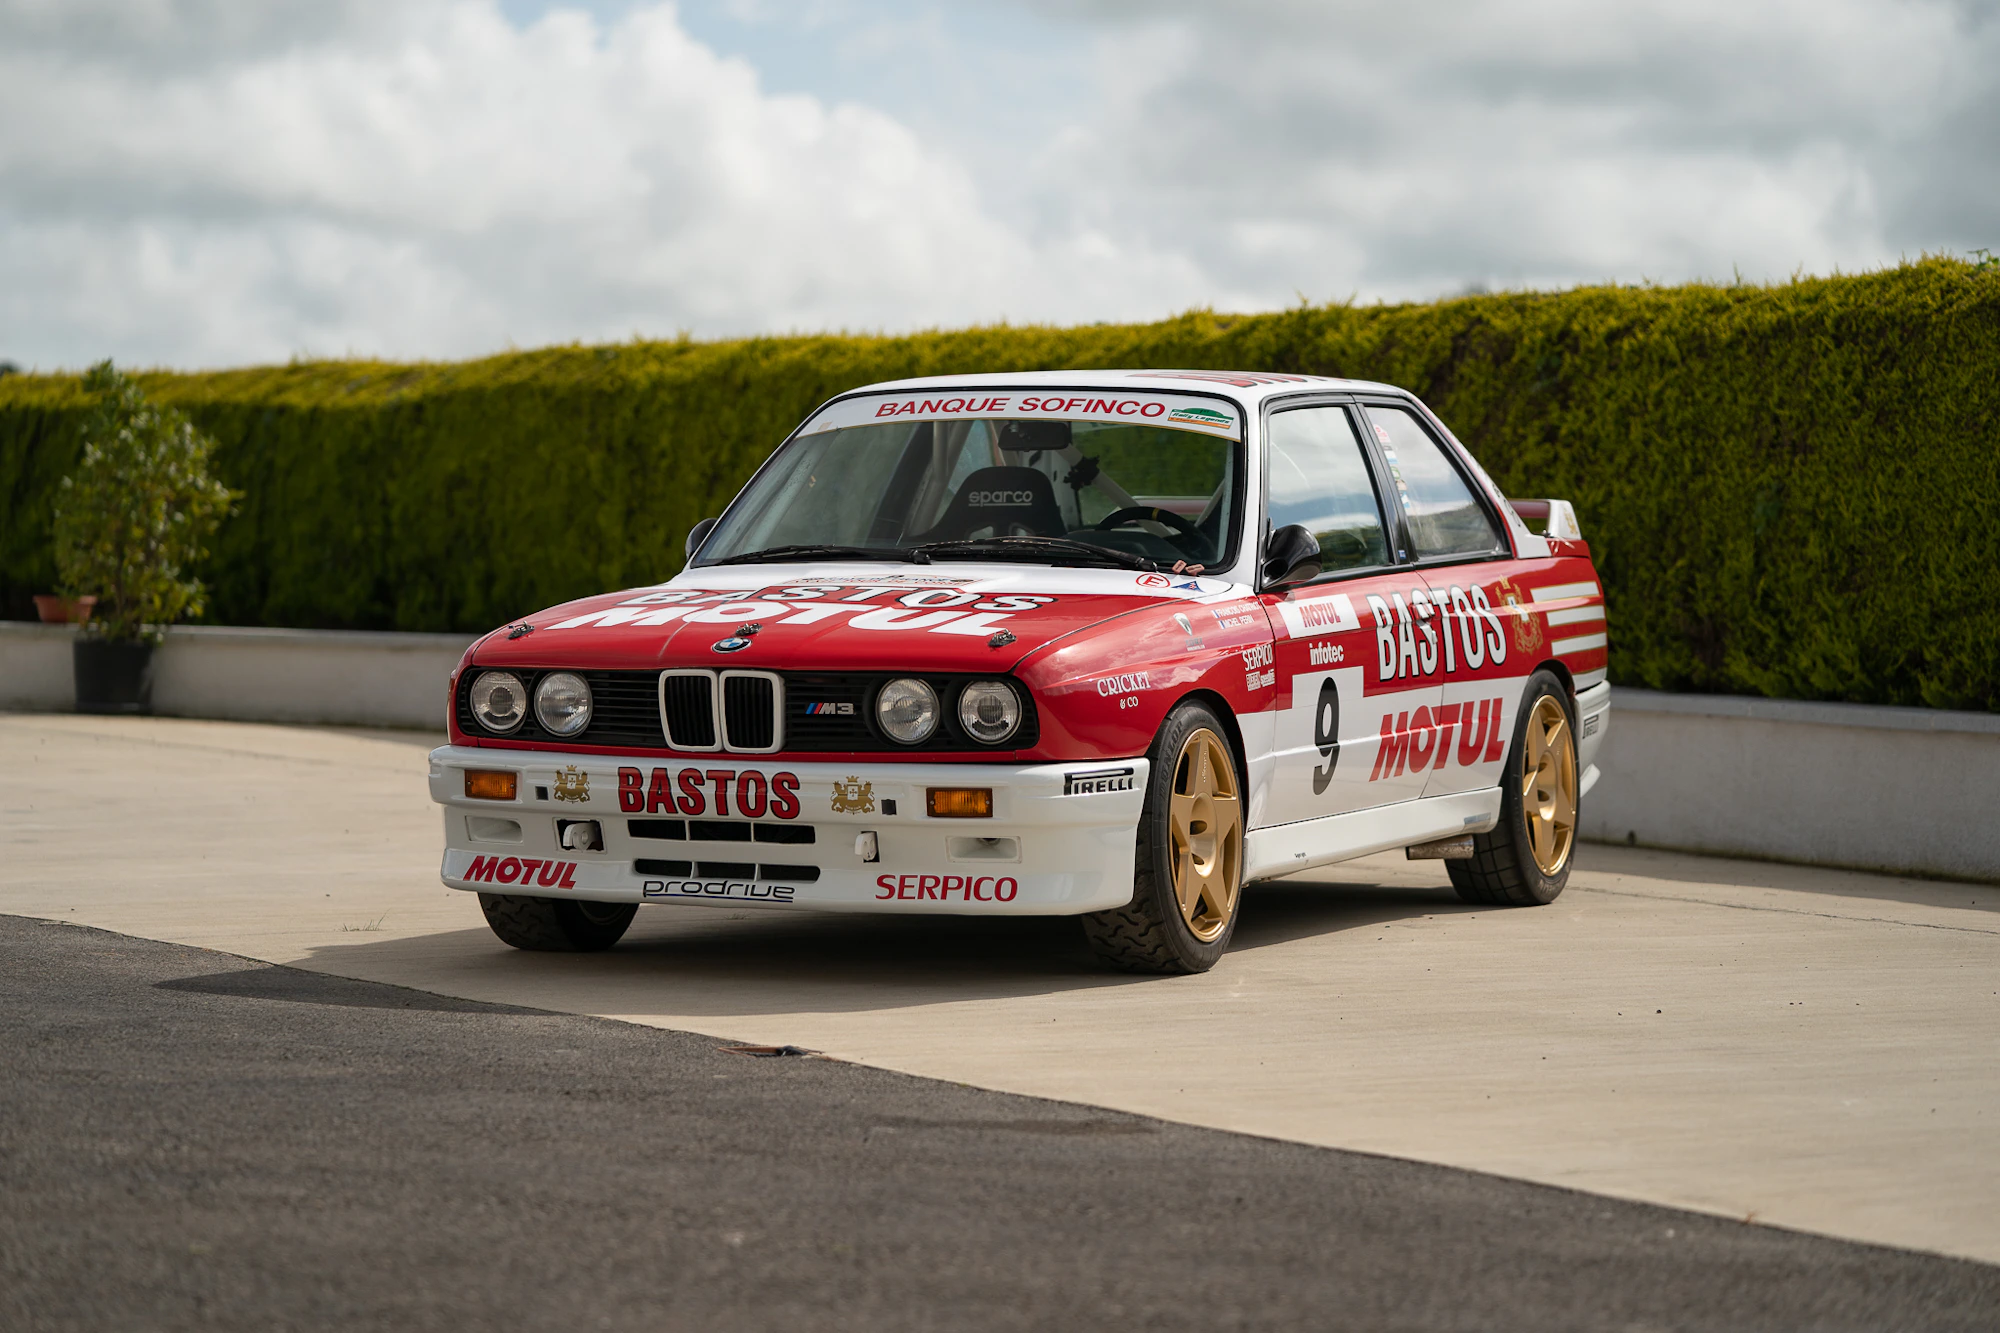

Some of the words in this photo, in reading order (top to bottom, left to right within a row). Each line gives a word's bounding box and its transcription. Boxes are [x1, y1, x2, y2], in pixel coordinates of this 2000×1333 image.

[875, 397, 1011, 418] BANQUE
[1018, 397, 1166, 418] SOFINCO
[968, 489, 1033, 507] sparco
[616, 585, 1058, 611] BASTOS
[544, 601, 1016, 637] MOTUL
[1299, 601, 1342, 628] MOTUL
[1366, 583, 1507, 682] BASTOS
[1242, 643, 1273, 672] SERPICO
[1310, 641, 1345, 666] infotec
[1097, 671, 1151, 698] CRICKET
[1127, 696, 1139, 708] CO
[1313, 676, 1341, 796] 9
[1369, 697, 1506, 782] MOTUL
[617, 766, 801, 820] BASTOS
[1063, 767, 1134, 796] PIRELLI
[463, 855, 578, 890] MOTUL
[643, 879, 796, 899] prodrive
[875, 874, 1018, 902] SERPICO
